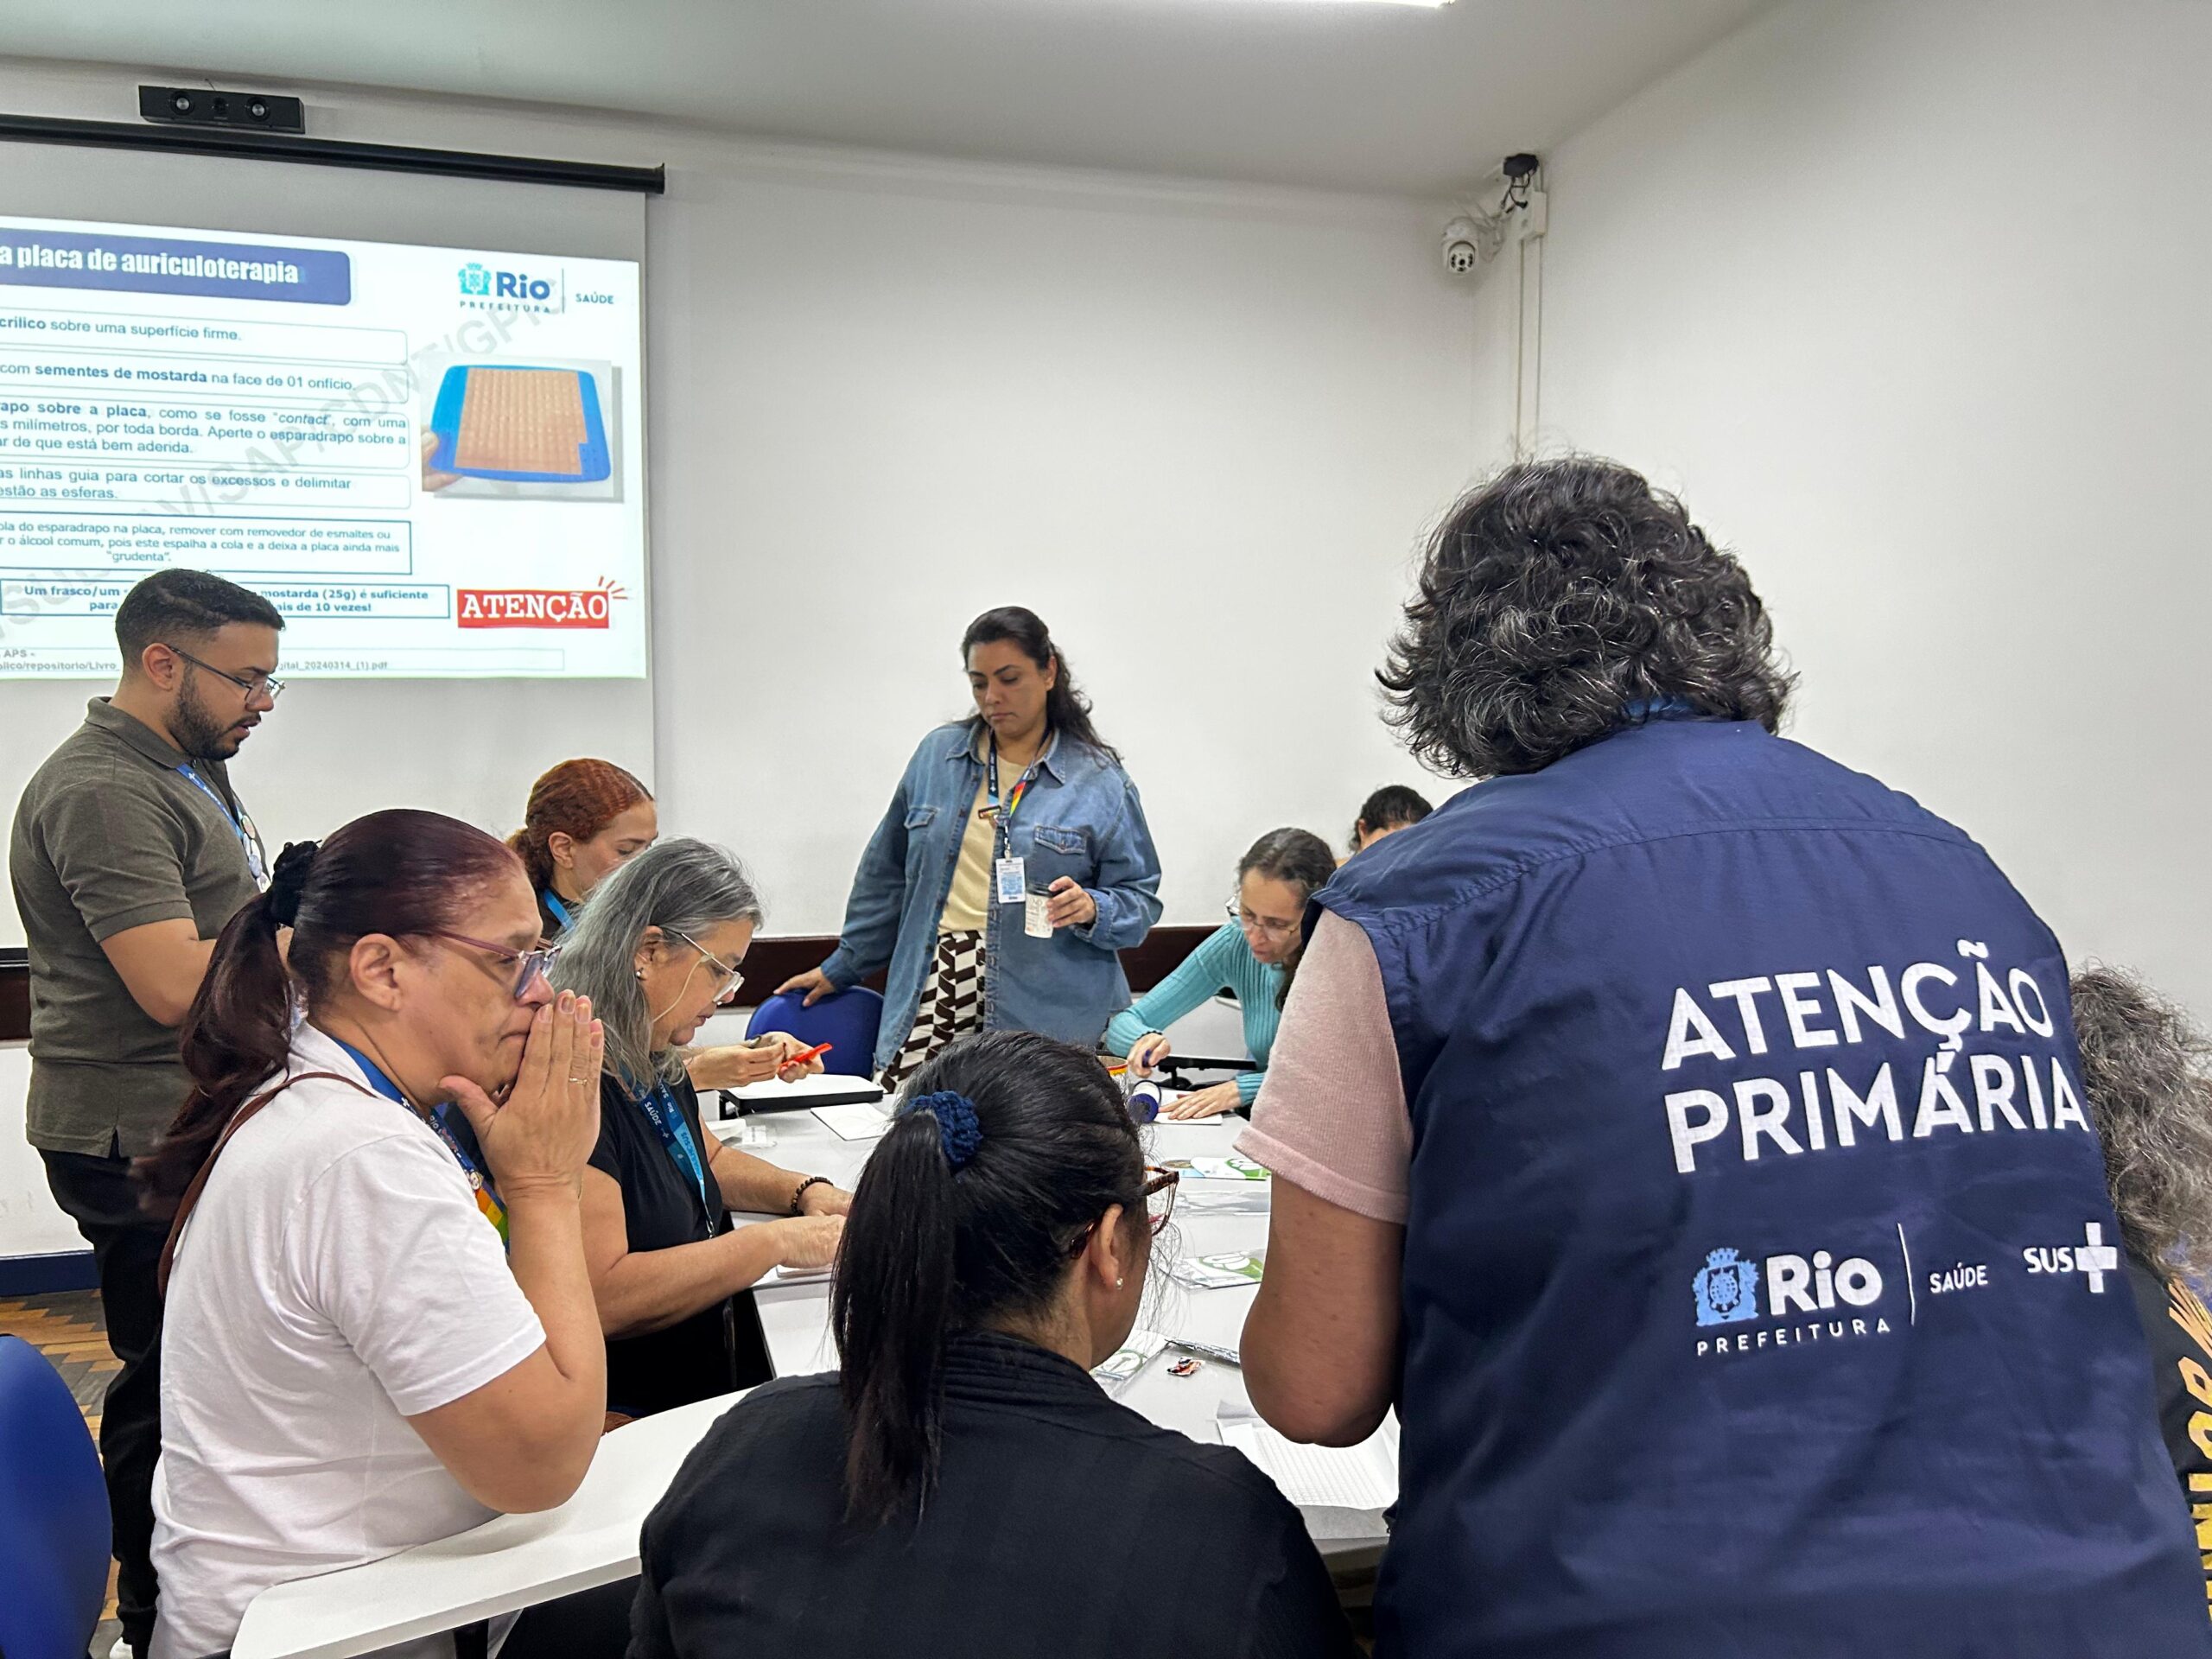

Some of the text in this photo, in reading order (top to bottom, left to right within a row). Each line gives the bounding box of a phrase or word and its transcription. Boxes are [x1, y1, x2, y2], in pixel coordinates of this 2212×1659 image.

[0, 245, 298, 283] a placa de auriculoterapia
[496, 271, 550, 300] Rio
[460, 301, 550, 313] PREFEITURA
[575, 291, 614, 304] SAÚDE
[50, 320, 91, 332] sobre
[95, 324, 126, 334] uma
[130, 325, 199, 338] superfície
[203, 327, 242, 340] firme.
[0, 364, 29, 374] com
[35, 365, 109, 378] sementes
[114, 367, 132, 378] de
[137, 370, 207, 383] mostarda
[212, 373, 229, 384] na
[233, 373, 262, 385] face
[266, 375, 283, 386] de
[287, 376, 302, 387] 01
[0, 402, 29, 414] apo
[37, 402, 81, 414] sobre
[90, 406, 98, 415] a
[107, 405, 150, 418] placa,
[159, 409, 197, 419] como
[205, 411, 221, 421] se
[229, 410, 266, 422] fosse
[343, 417, 371, 427] com
[378, 418, 406, 429] uma
[13, 435, 30, 448] de
[35, 439, 62, 450] que
[67, 438, 97, 449] está
[102, 439, 132, 451] bem
[97, 424, 120, 435] por
[124, 423, 154, 435] toda
[159, 424, 203, 436] borda.
[207, 426, 253, 439] Aperte
[257, 430, 265, 439] o
[270, 431, 353, 444] esparadrapo
[359, 434, 394, 444] sobre
[398, 435, 406, 444] a
[20, 467, 62, 480] linhas
[69, 469, 99, 483] guia
[105, 472, 137, 484] para
[143, 473, 184, 484] cortar
[189, 475, 207, 485] os
[212, 476, 276, 486] excessos
[281, 479, 289, 487] e
[296, 477, 352, 489] delimitar
[41, 487, 57, 497] as
[61, 486, 118, 499] esferas.
[19, 522, 34, 531] do
[38, 523, 110, 534] esparadrapo
[114, 524, 128, 533] na
[132, 524, 166, 535] placa,
[169, 526, 216, 536] remover
[220, 527, 244, 536] com
[247, 528, 306, 537] removedor
[310, 529, 323, 537] de
[327, 530, 373, 538] esmaltes
[8, 537, 16, 545] o
[19, 534, 54, 545] álcool
[57, 537, 104, 548] comum,
[108, 537, 131, 549] pois
[136, 538, 159, 547] este
[163, 539, 207, 550] espalha
[221, 540, 244, 549] cola
[268, 541, 297, 550] deixa
[311, 543, 339, 552] placa
[343, 543, 372, 552] ainda
[375, 543, 400, 552] mais
[24, 586, 429, 601] Um frasco/um mostarda (25g) é suficiente
[90, 601, 118, 611] para
[296, 602, 311, 612] de
[315, 602, 330, 612] 10
[334, 603, 372, 612] vezes!
[461, 591, 607, 622] ATENÇÃO
[3, 649, 28, 658] APS
[1662, 938, 2054, 1070] ATENÇÃO
[644, 1101, 663, 1126] SAÚDE
[1664, 1051, 2089, 1173] PRIMÁRIA
[2023, 1245, 2074, 1274] SUS
[1765, 1250, 1883, 1316] Rio
[1929, 1262, 1988, 1294] SAÚDE
[1696, 1318, 1891, 1356] PREFEITURA
